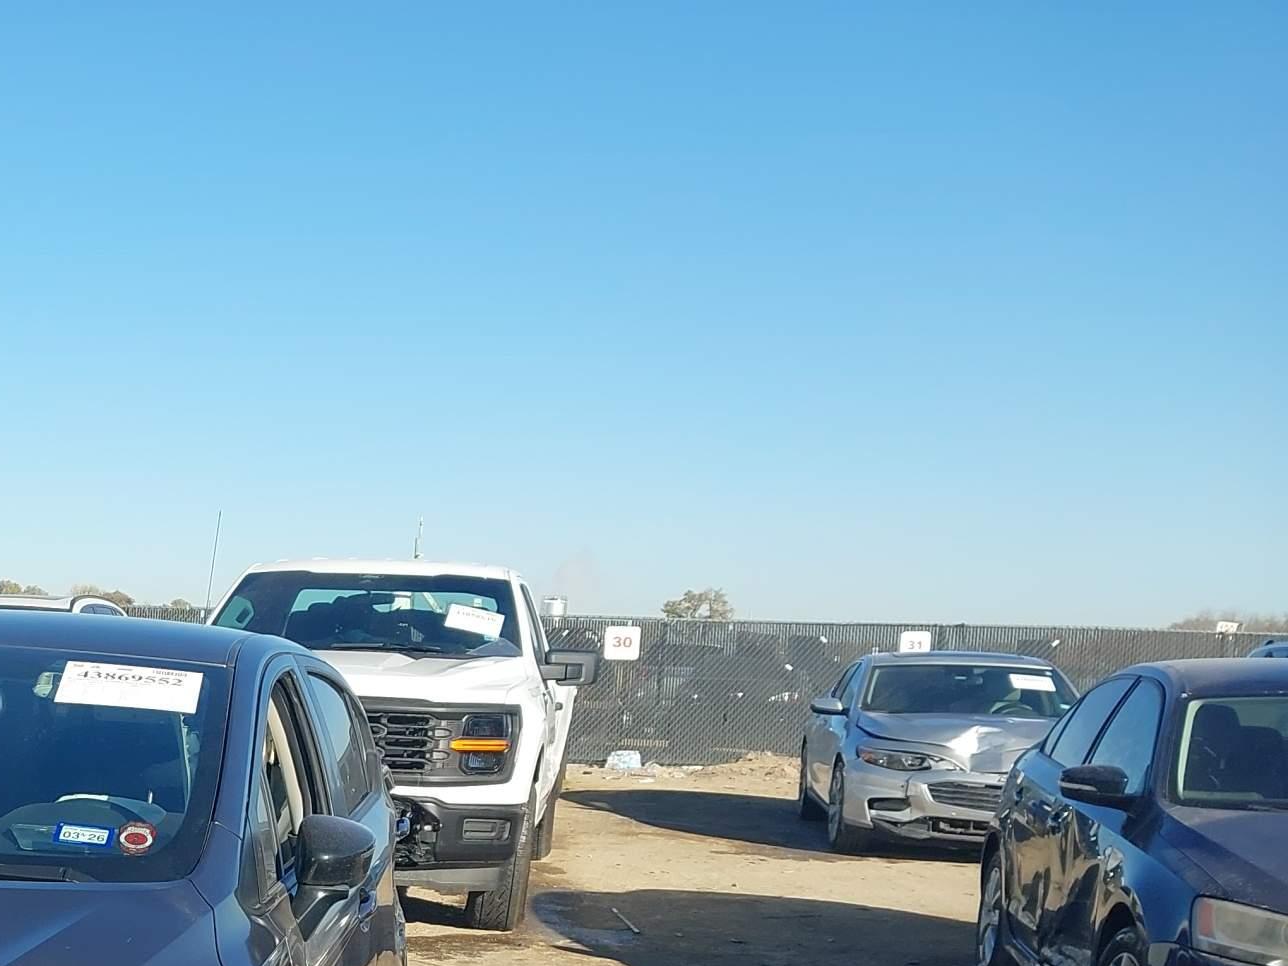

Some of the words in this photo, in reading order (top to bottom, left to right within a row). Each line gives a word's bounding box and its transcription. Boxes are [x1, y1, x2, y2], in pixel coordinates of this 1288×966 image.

[612, 636, 632, 648] 30
[907, 640, 922, 650] 31
[76, 670, 184, 687] 43869552
[62, 830, 80, 840] 03
[87, 833, 105, 842] 26
